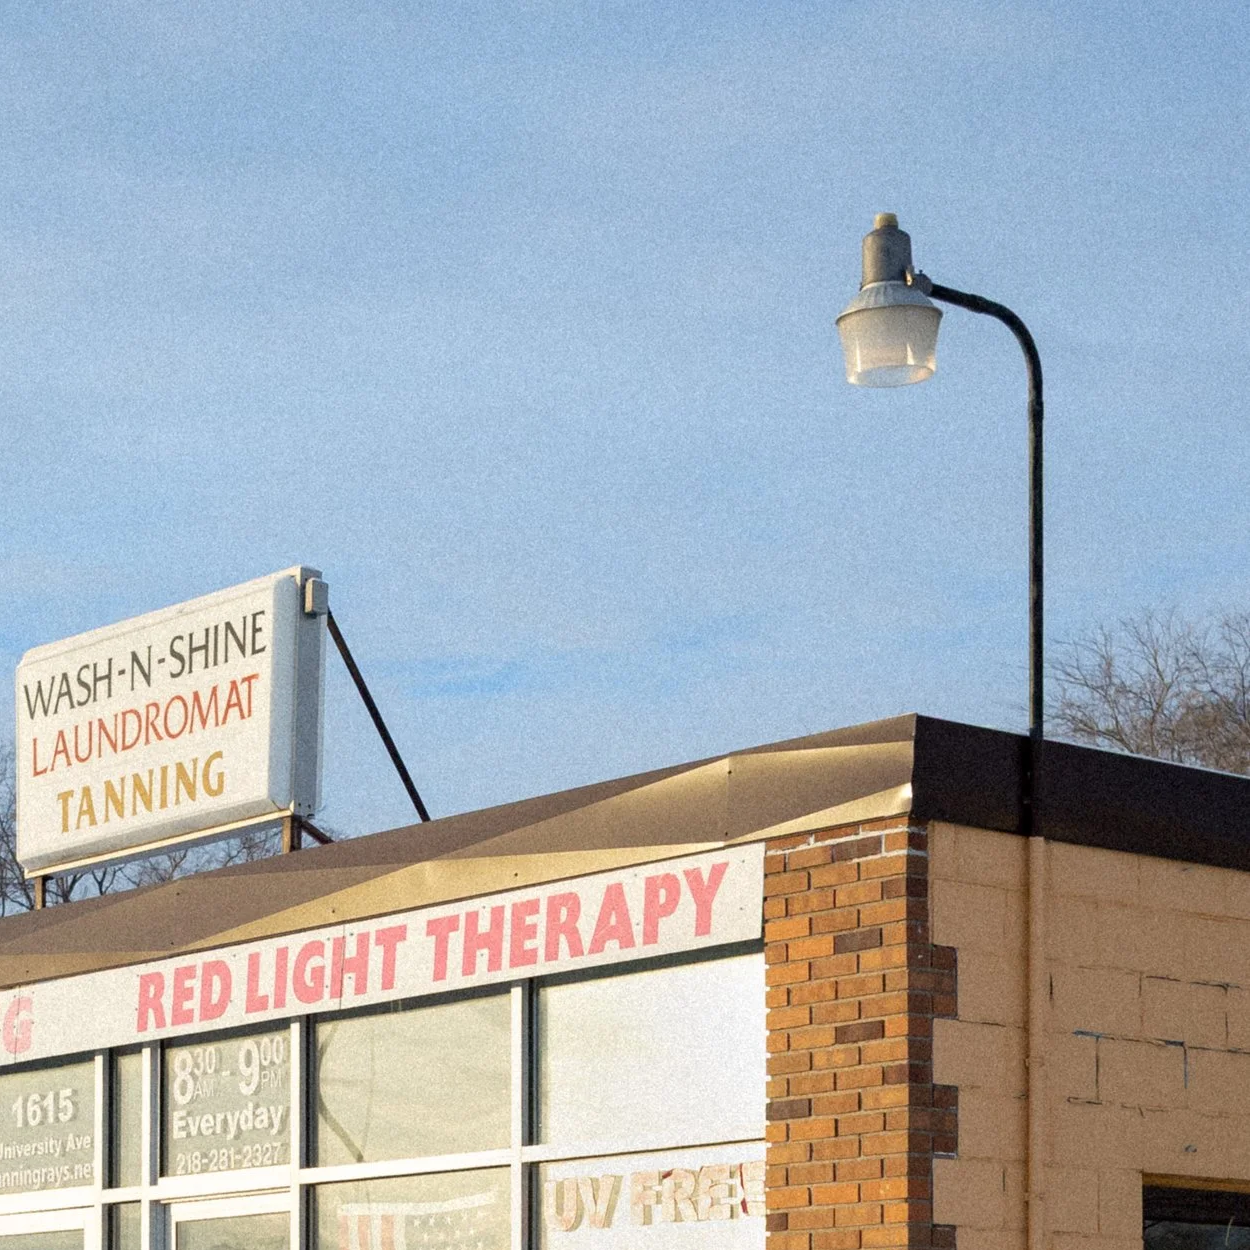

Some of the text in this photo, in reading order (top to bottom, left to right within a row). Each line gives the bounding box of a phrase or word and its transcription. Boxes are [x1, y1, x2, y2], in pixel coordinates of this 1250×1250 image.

[23, 610, 268, 720] WASH-N-SHINE
[31, 673, 260, 778] LAUNDROMAT
[57, 750, 225, 834] TANNING
[136, 861, 730, 1033] RED LIGHT THERAPY
[261, 1068, 282, 1089] PM
[12, 1088, 74, 1128] 1615
[172, 1101, 283, 1140] Everyday
[66, 1133, 91, 1152] Ave
[176, 1142, 281, 1175] 218-281-2327
[544, 1174, 616, 1232] UV
